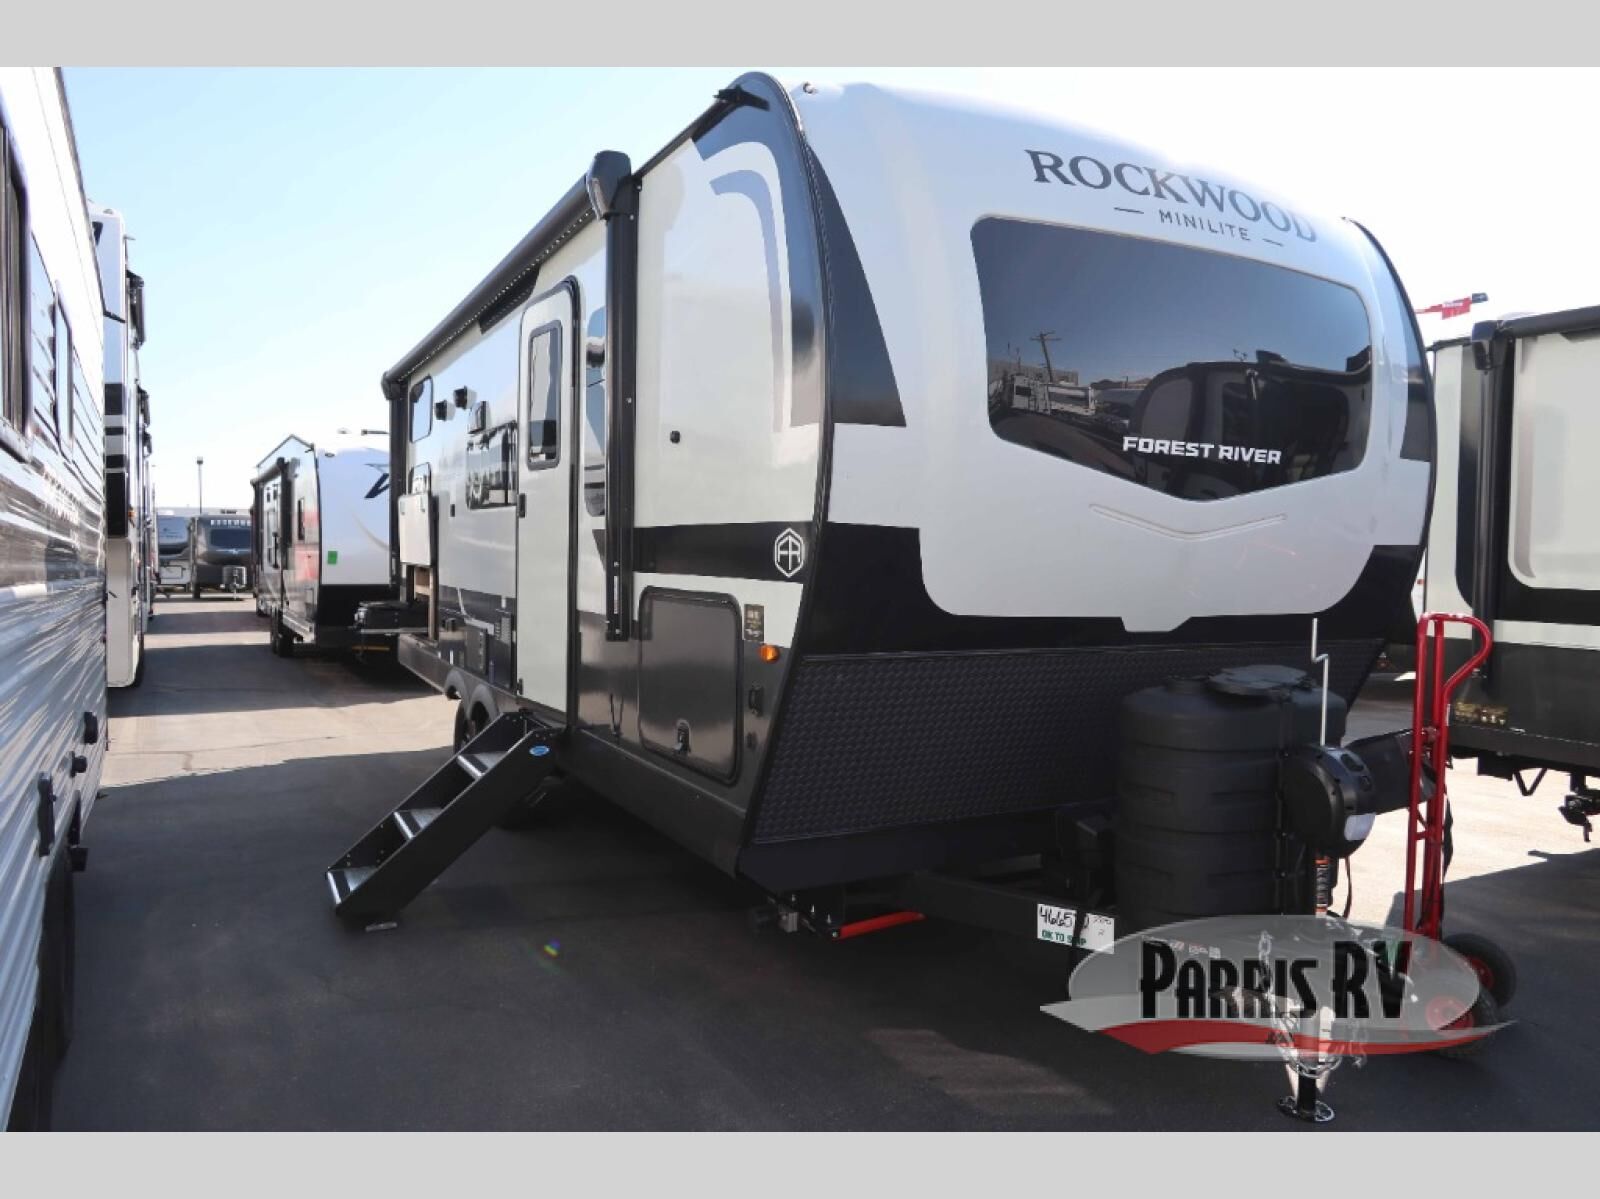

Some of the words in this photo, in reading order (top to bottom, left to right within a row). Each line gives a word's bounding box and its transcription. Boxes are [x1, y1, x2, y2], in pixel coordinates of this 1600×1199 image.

[1024, 149, 1317, 243] ROCKWOOD
[1158, 208, 1251, 242] MINILITE
[1122, 436, 1215, 459] FOREST
[1218, 444, 1282, 465] RIVER
